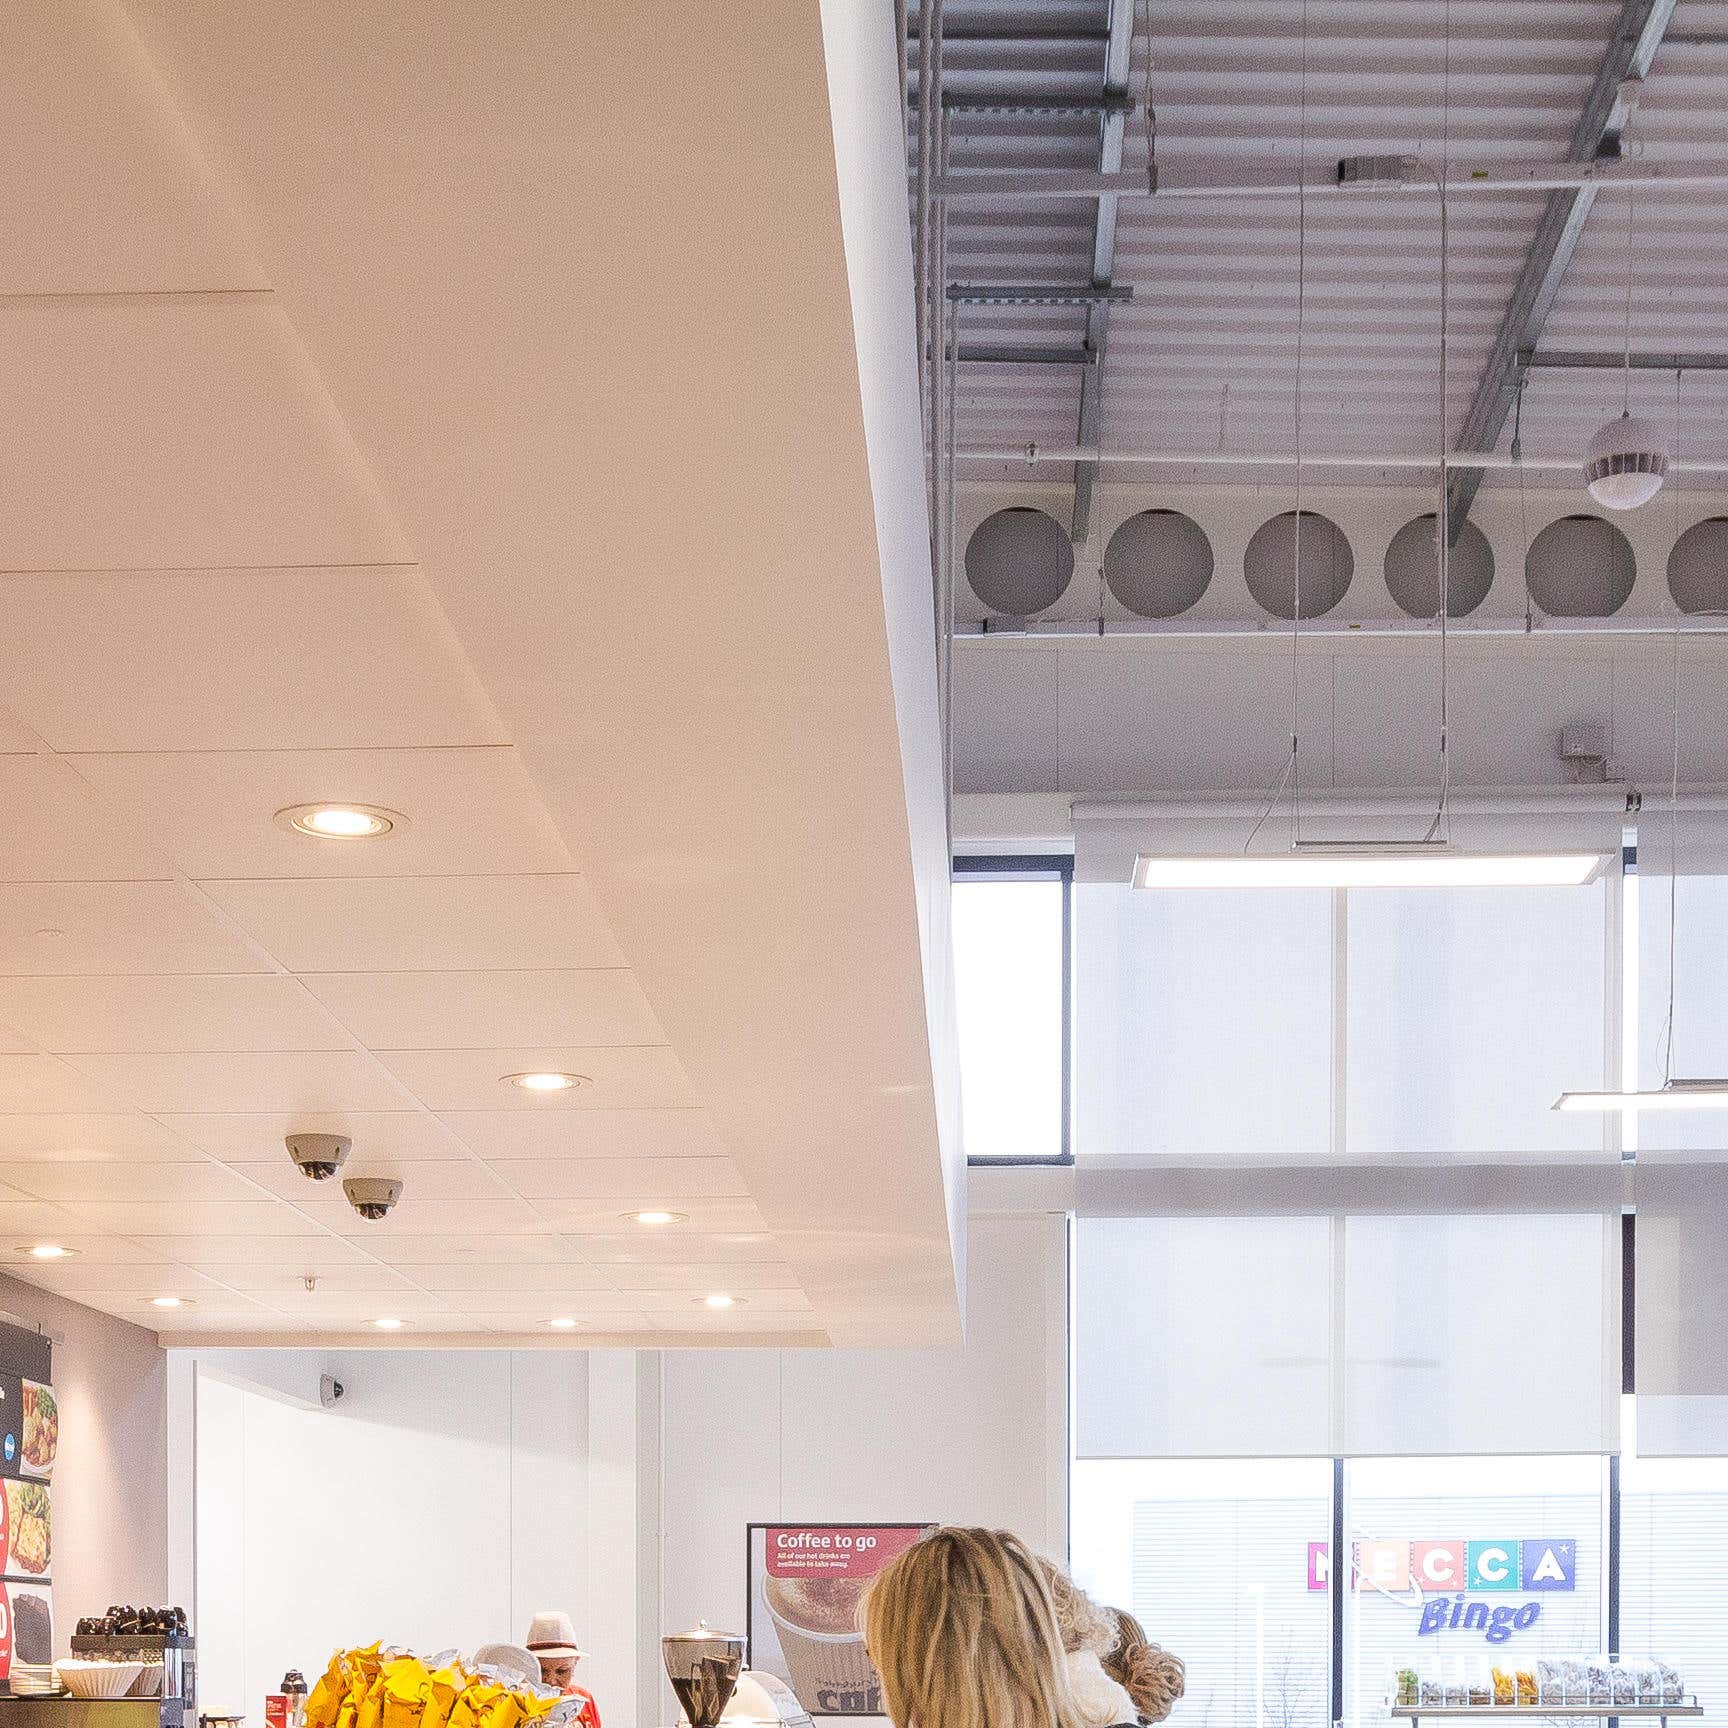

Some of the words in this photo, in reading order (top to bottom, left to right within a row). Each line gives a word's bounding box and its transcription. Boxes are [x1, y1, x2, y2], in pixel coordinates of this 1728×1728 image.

[776, 1533, 831, 1549] Coffee
[834, 1534, 852, 1548] to
[856, 1535, 877, 1552] go
[786, 1552, 794, 1560] of
[805, 1552, 818, 1560] hot
[1418, 1593, 1541, 1644] Bingo
